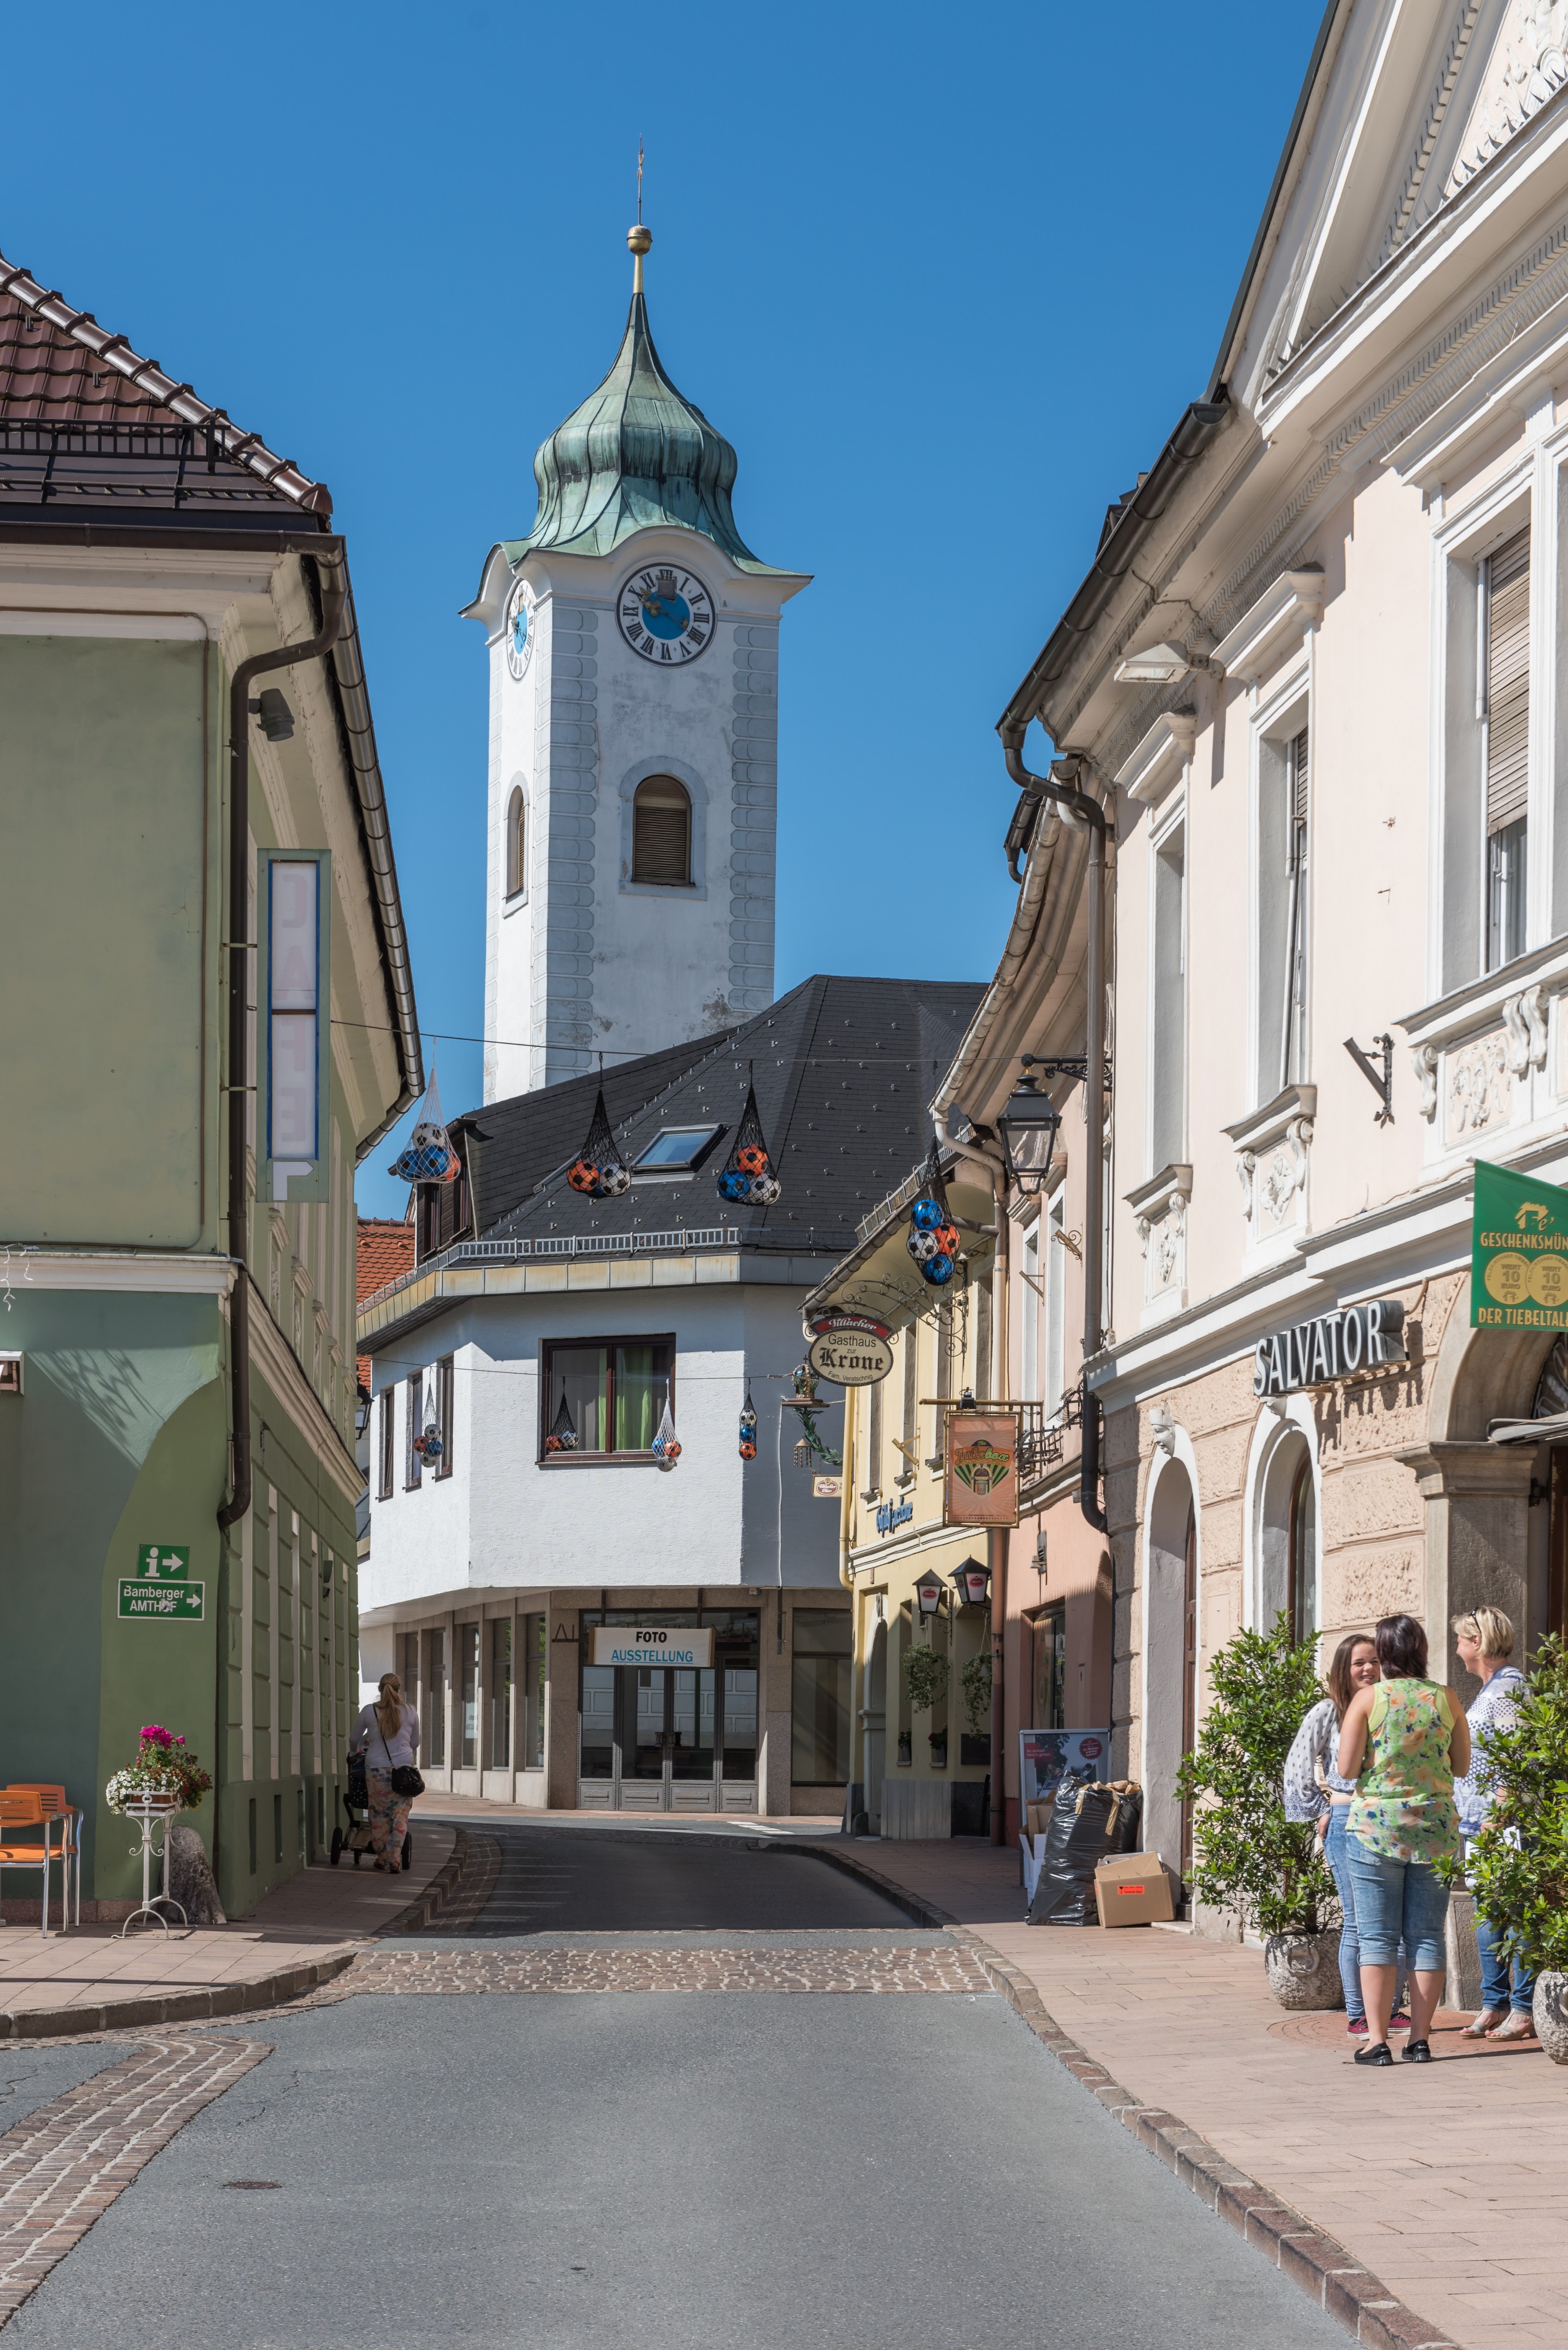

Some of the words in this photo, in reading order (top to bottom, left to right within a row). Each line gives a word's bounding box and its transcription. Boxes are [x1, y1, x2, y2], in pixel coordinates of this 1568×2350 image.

[640, 572, 656, 590] XI
[679, 576, 690, 592] I
[689, 592, 706, 606] II
[623, 605, 639, 617] IX
[693, 612, 710, 624] III
[660, 642, 672, 660] VI
[679, 640, 692, 657] V
[1502, 1270, 1520, 1283] 10
[1543, 1273, 1561, 1284] 10
[1478, 1307, 1502, 1324] DER
[828, 1334, 877, 1348] Gasthaus
[1254, 1300, 1385, 1396] SALVATOR
[820, 1347, 884, 1371] Krone
[828, 1371, 841, 1380] Fam.
[955, 1447, 1009, 1465] Jukebox
[124, 1585, 184, 1601] Bamberger
[636, 1631, 667, 1643] FOTO
[612, 1649, 693, 1662] AUSSTELLUNG
